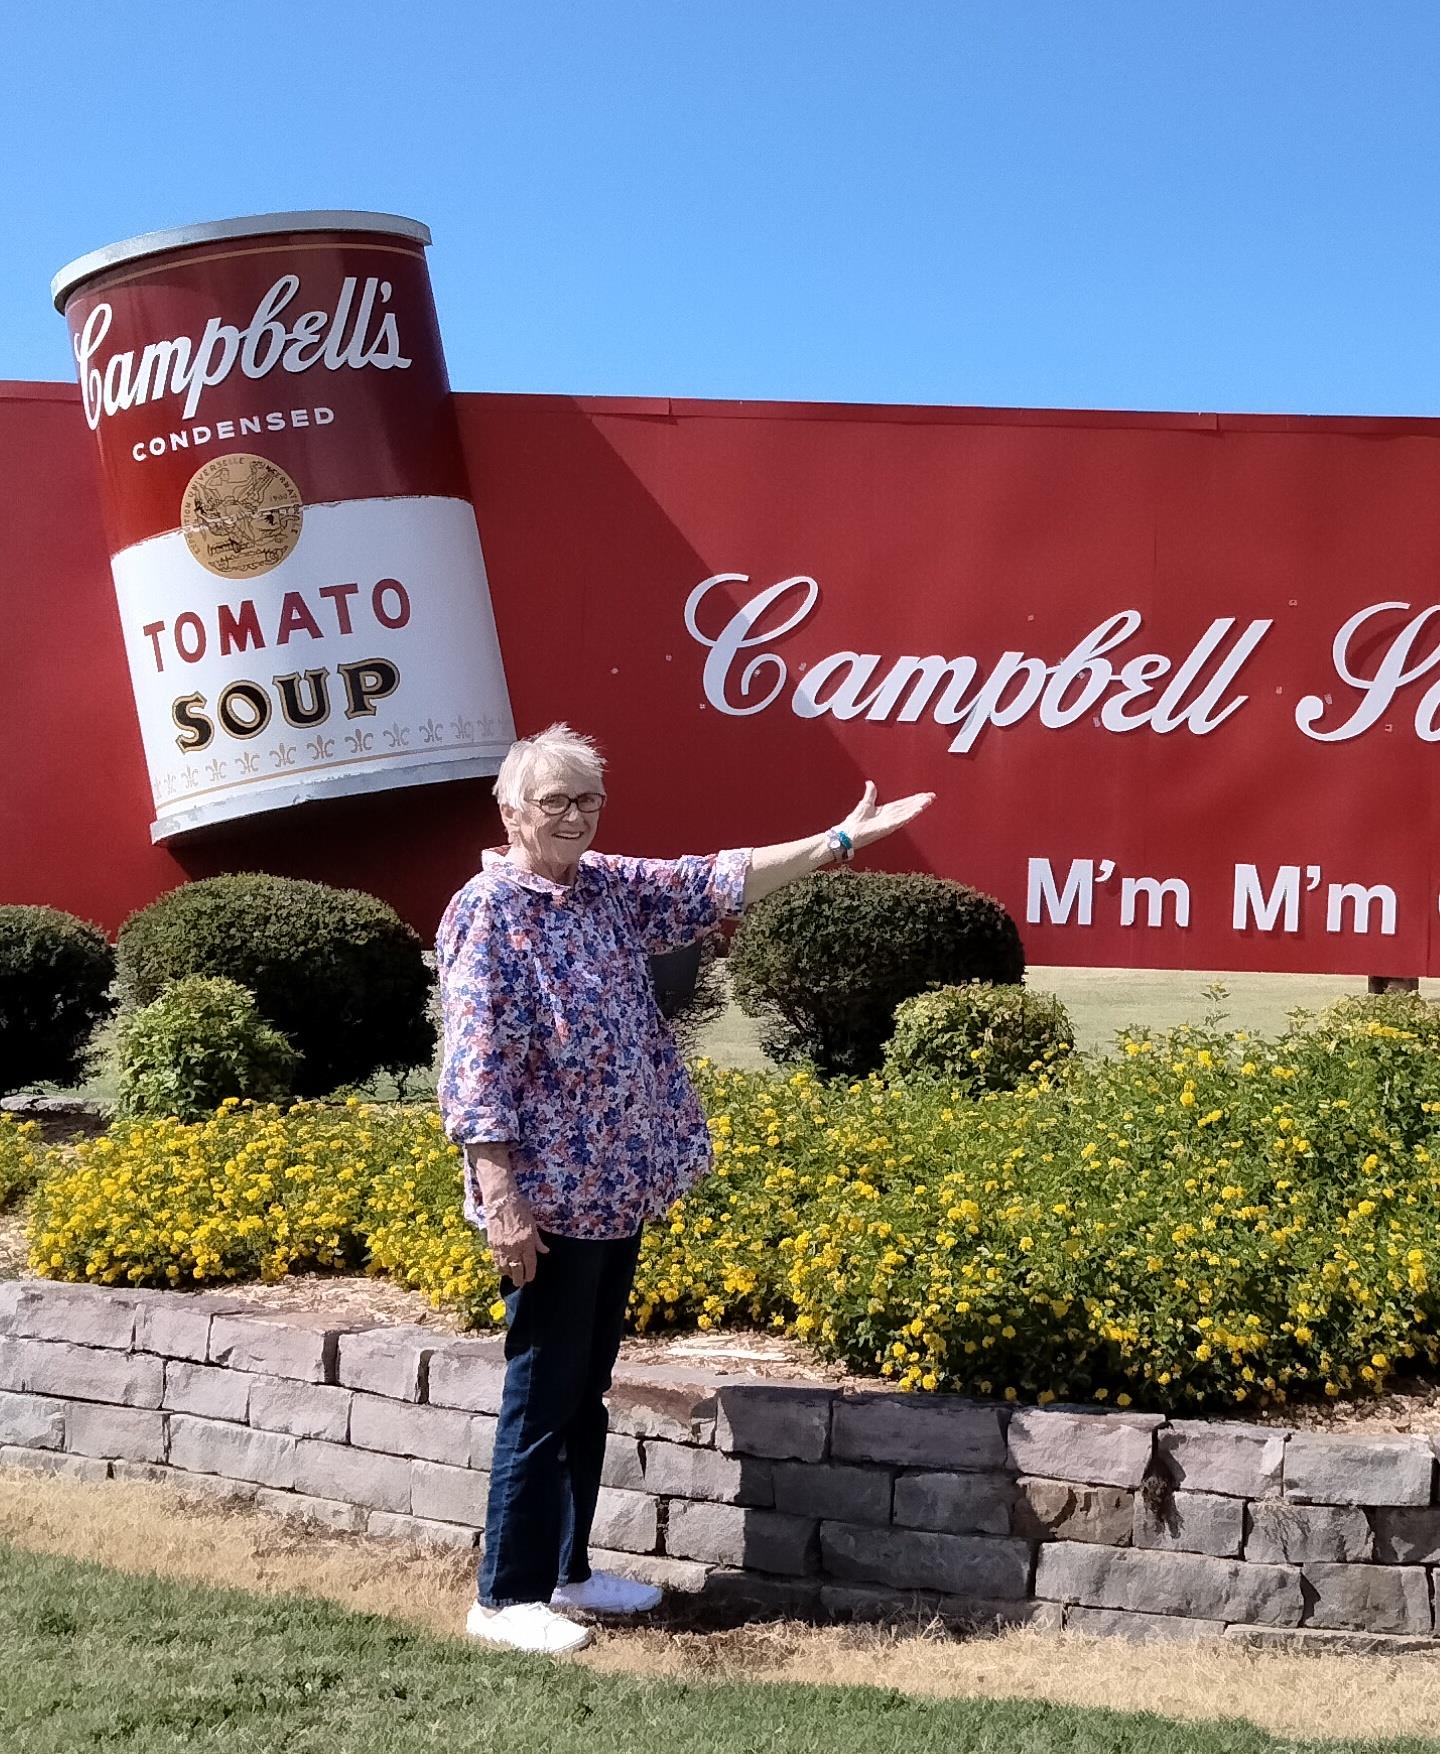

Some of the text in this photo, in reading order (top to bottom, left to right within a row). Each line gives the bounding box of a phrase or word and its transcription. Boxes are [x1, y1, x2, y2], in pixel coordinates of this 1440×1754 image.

[74, 274, 412, 430] Campbell's
[133, 407, 334, 462] CONDENSED
[143, 578, 411, 672] TOMATO
[684, 573, 1273, 753] Campbell
[172, 657, 401, 754] SOUP
[1026, 858, 1190, 928] M'm
[1232, 863, 1397, 935] M'm
